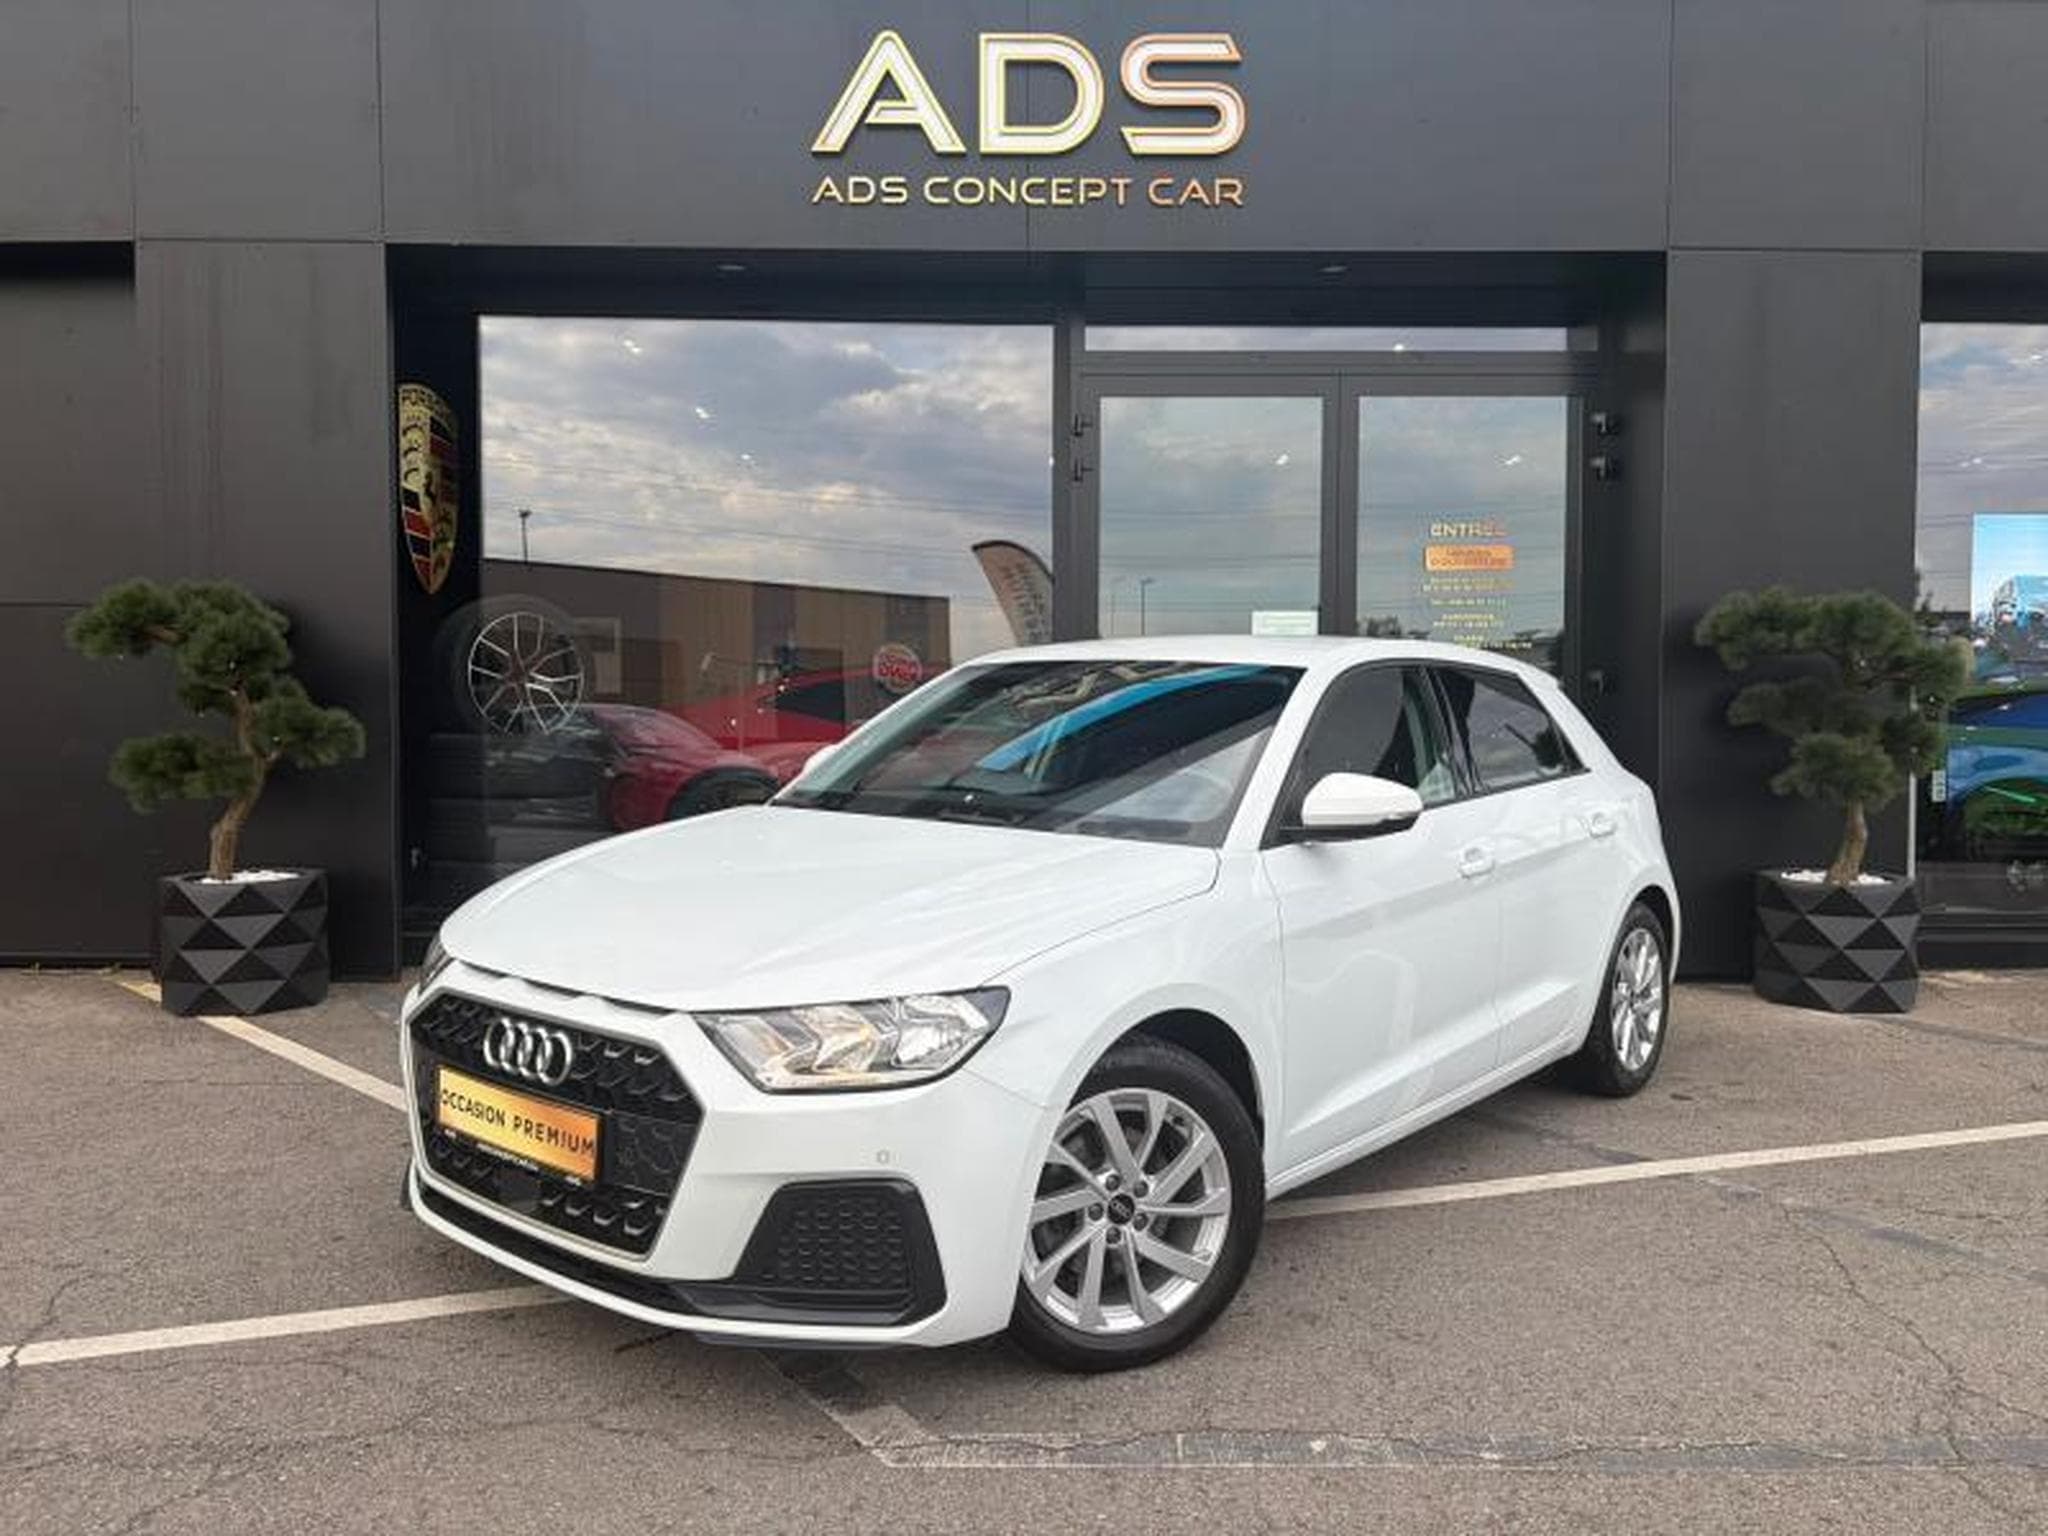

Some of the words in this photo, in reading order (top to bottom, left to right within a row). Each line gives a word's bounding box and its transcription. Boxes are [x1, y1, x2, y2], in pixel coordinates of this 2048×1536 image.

[811, 29, 1246, 155] ADS
[811, 176, 908, 205] ADS
[924, 177, 1132, 205] CONCEPT
[1148, 178, 1245, 206] CAR
[440, 1089, 506, 1127] OCCASION
[513, 1115, 596, 1154] PREMIUM
